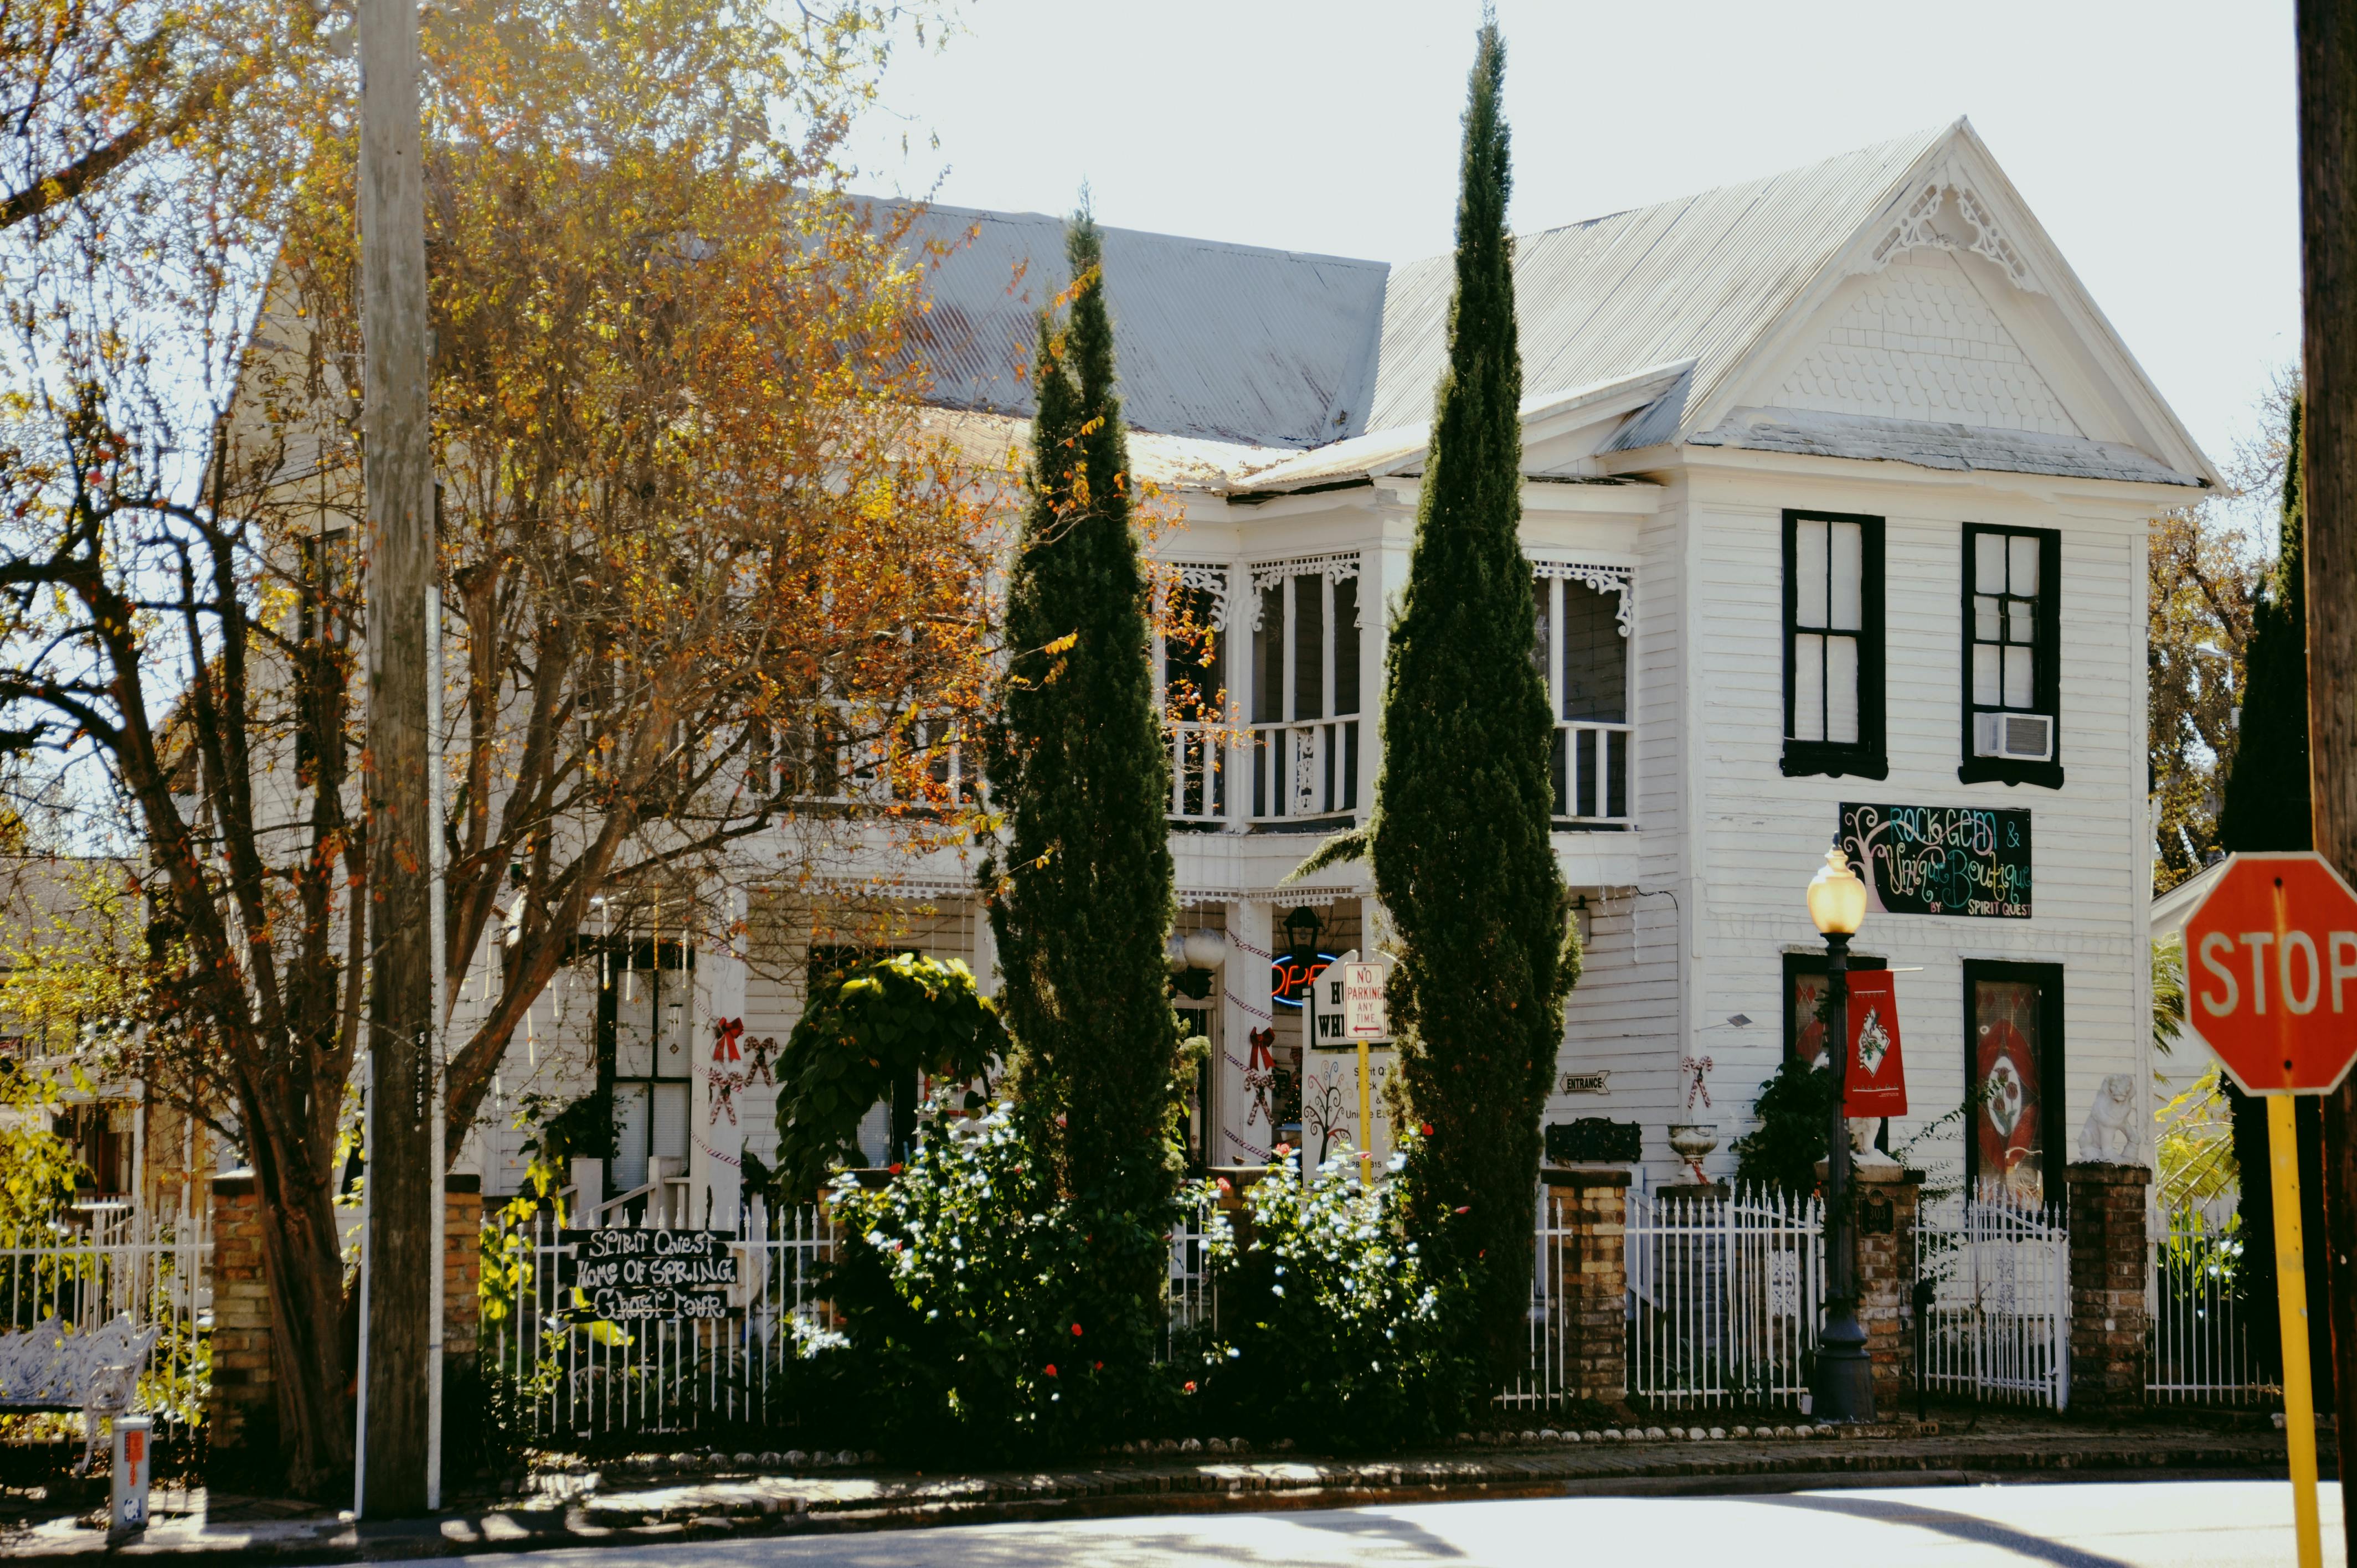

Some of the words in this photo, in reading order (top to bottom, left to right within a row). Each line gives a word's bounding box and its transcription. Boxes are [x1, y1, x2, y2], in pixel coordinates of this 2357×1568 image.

[2007, 822, 2020, 848] &
[1886, 842, 1949, 902] Unique
[1942, 849, 2032, 908] Boutique
[1968, 899, 1999, 915] SPIRIT
[2003, 904, 2031, 916] QUEST
[1357, 970, 1372, 983] NO
[2199, 930, 2357, 1018] STOP
[1347, 987, 1383, 1000] PARKING
[1357, 1002, 1373, 1012] ANY
[1356, 1014, 1375, 1023] TIME
[1567, 1077, 1602, 1090] ENTRANCE
[1869, 1207, 1886, 1220] 303
[624, 1260, 646, 1283] OF
[650, 1257, 737, 1285] SPRING
[666, 1287, 726, 1319] TOUR
